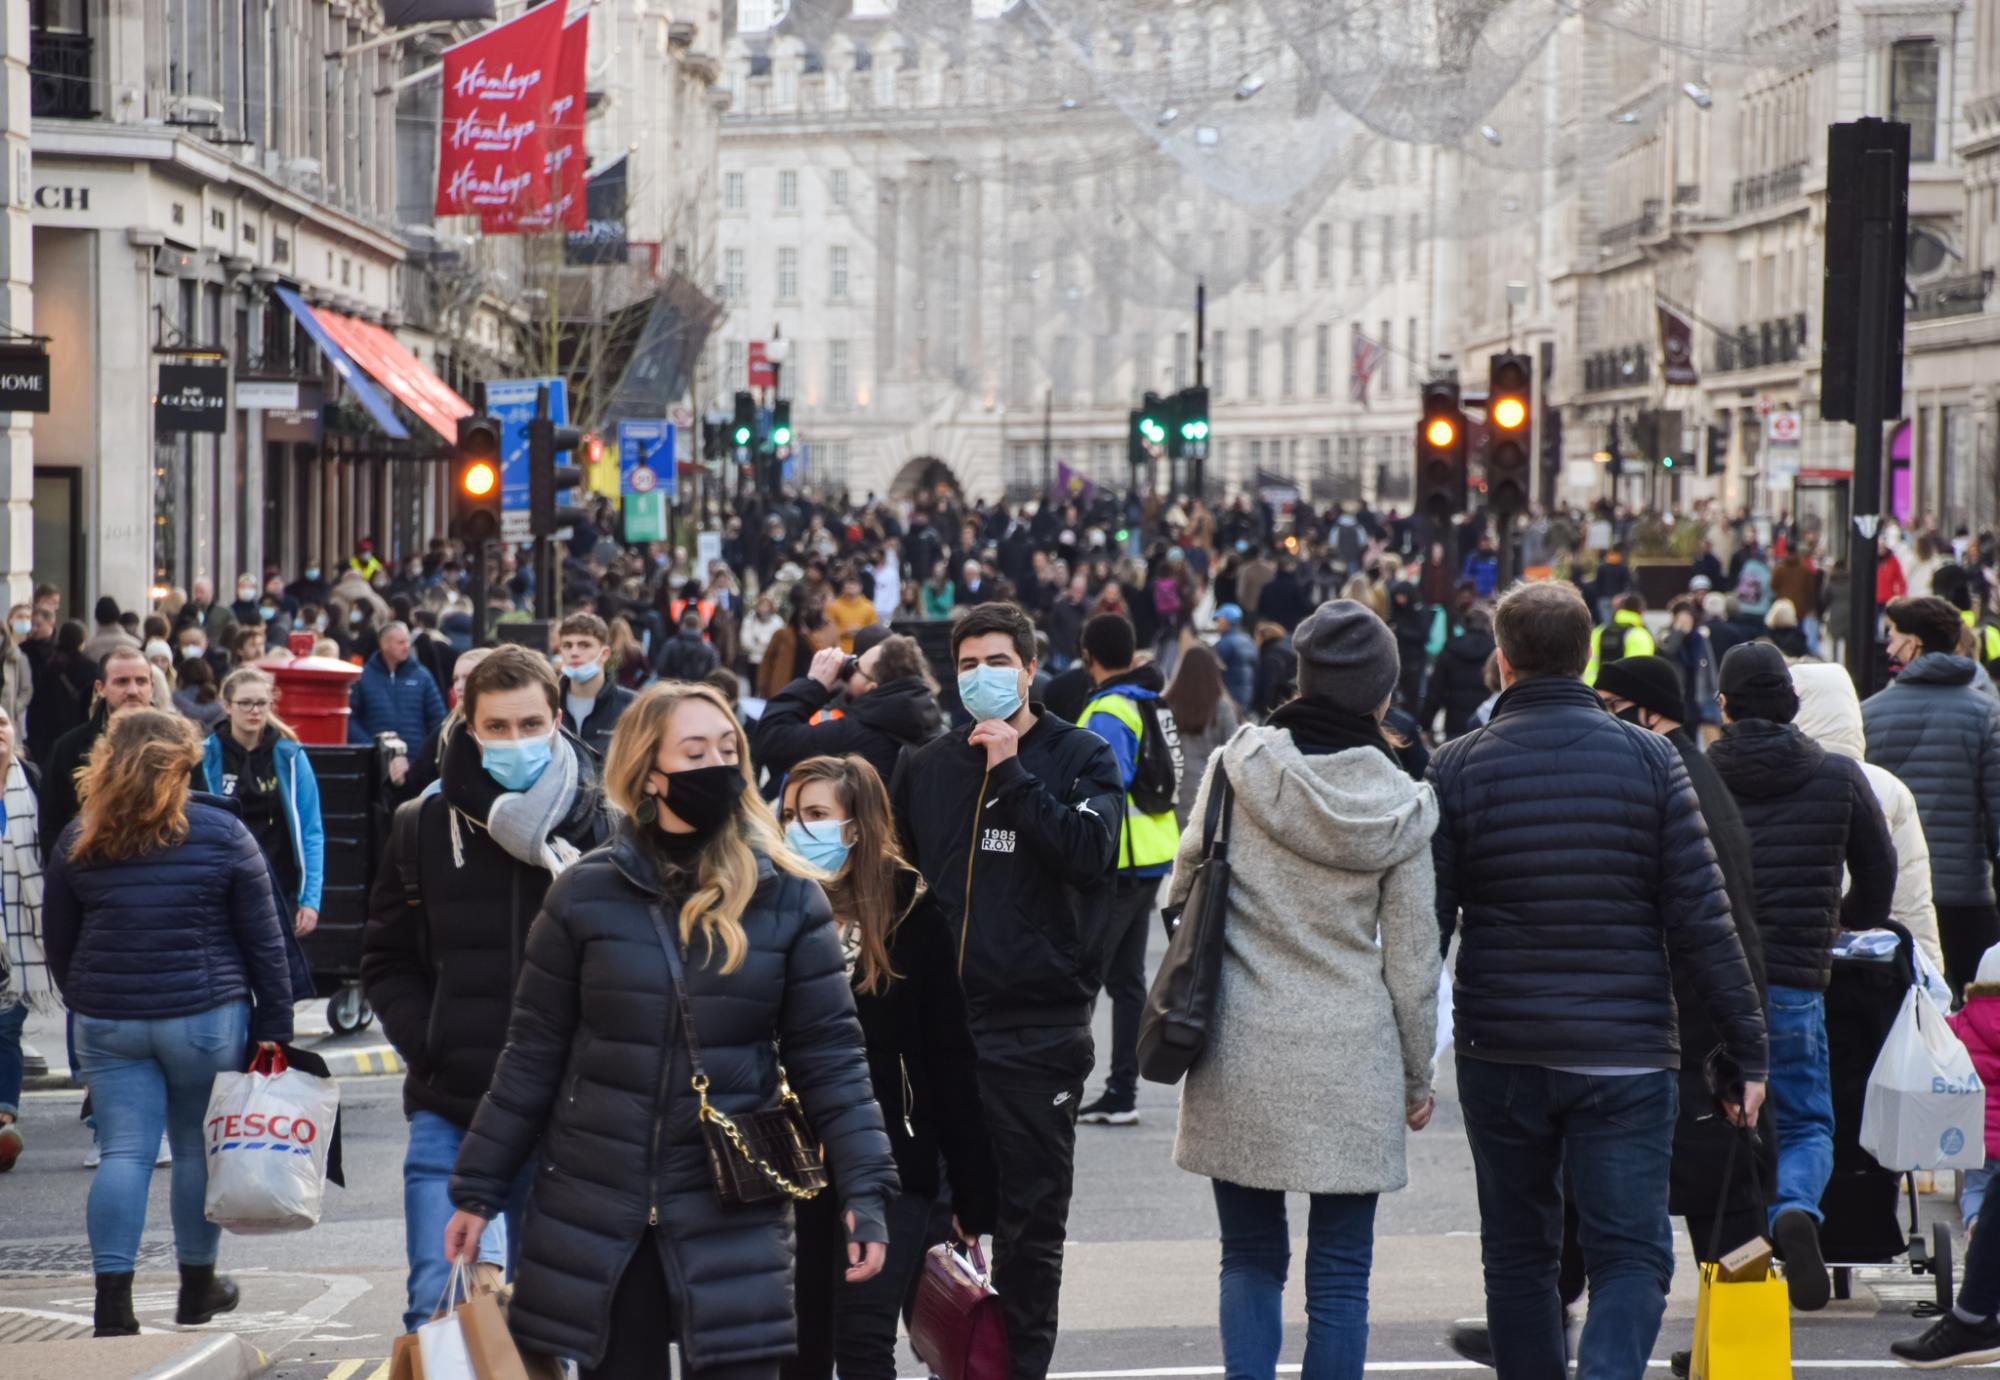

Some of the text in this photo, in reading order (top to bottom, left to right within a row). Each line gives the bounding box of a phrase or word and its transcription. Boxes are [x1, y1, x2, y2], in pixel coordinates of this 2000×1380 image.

[452, 57, 541, 100] Hamleys
[450, 107, 535, 151] Hamleys
[445, 159, 531, 204] Hamleys
[984, 828, 1016, 841] 1985
[208, 1113, 317, 1145] TESCO
